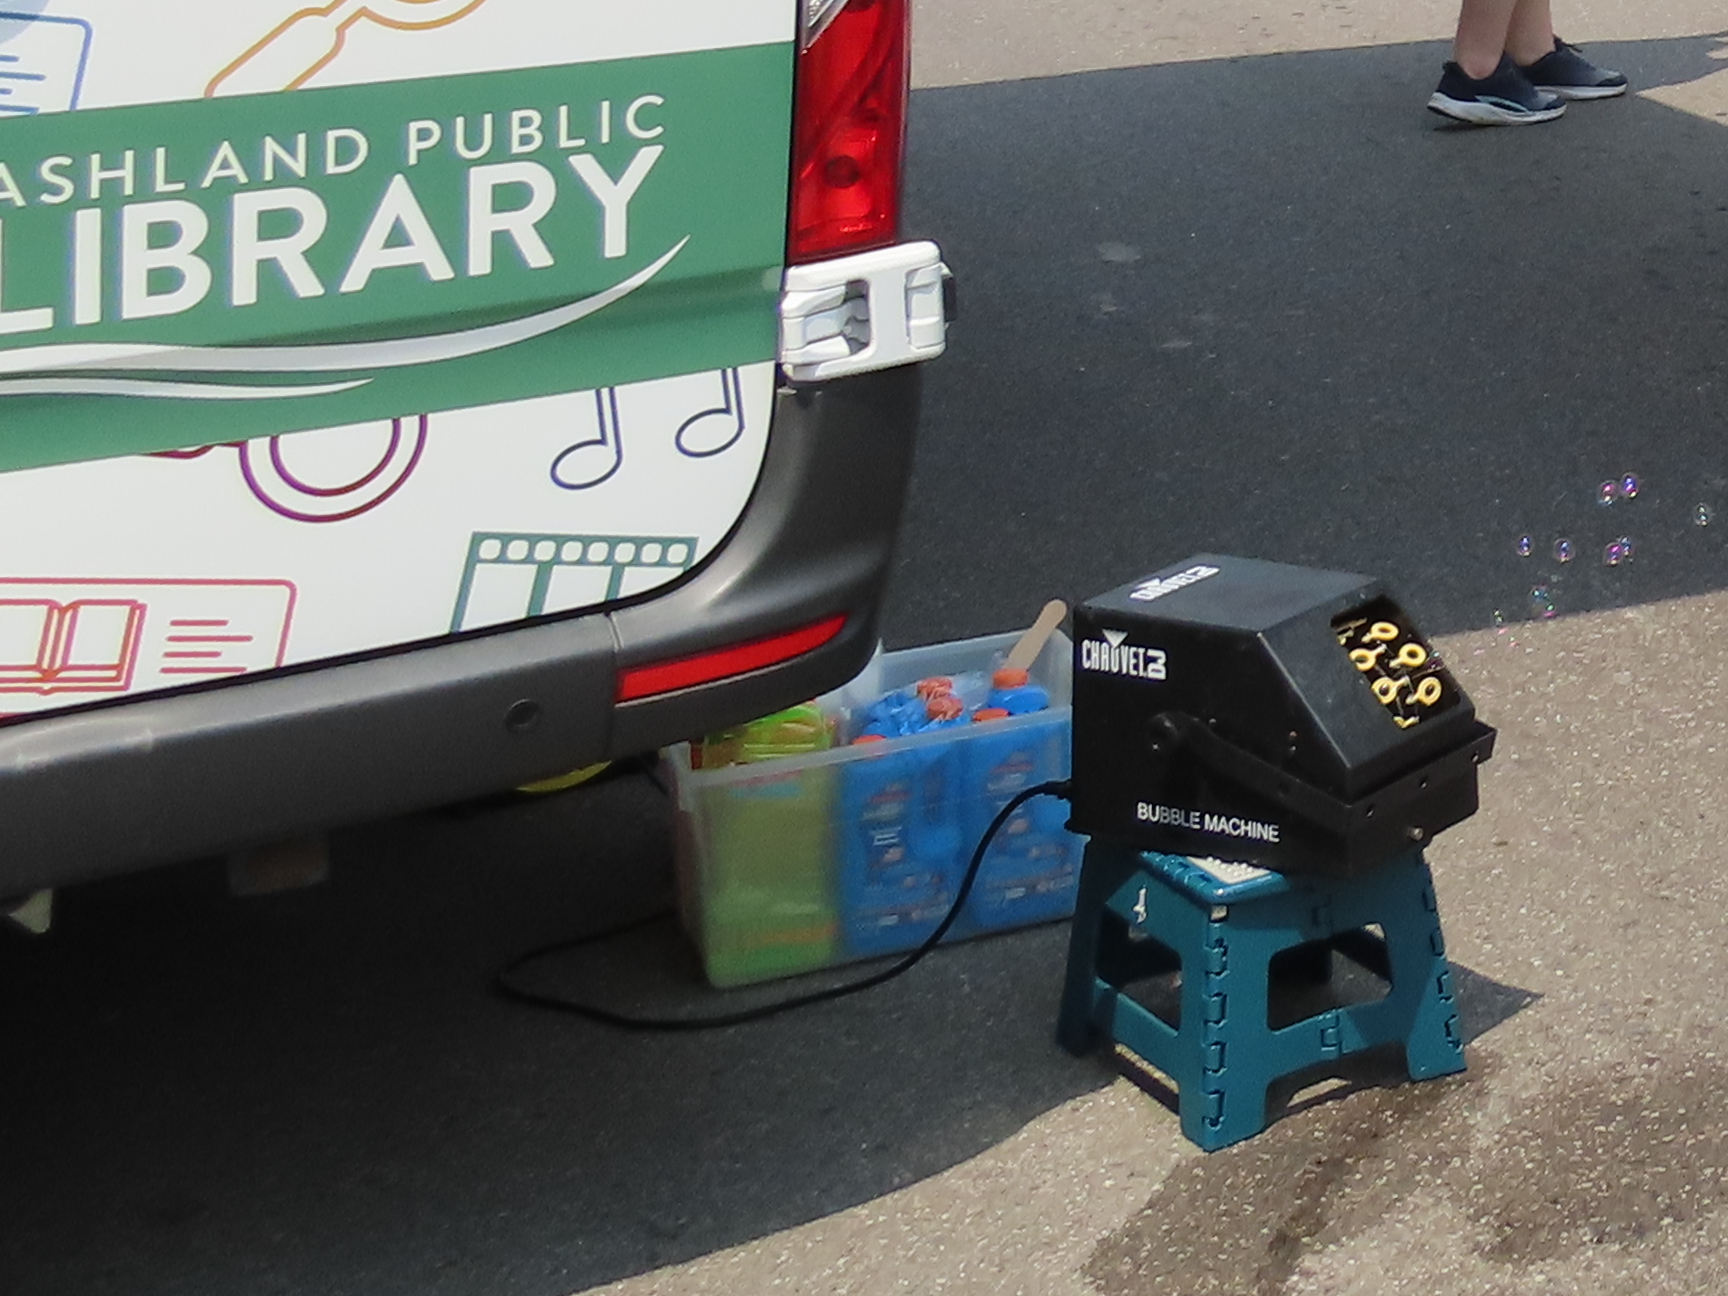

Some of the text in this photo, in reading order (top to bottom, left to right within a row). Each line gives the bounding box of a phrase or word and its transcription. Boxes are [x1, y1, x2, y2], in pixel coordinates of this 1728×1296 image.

[407, 94, 666, 165] PUBLIC
[1082, 639, 1148, 678] CHAUVET
[1137, 802, 1280, 843] BUBBLE MACHINE
